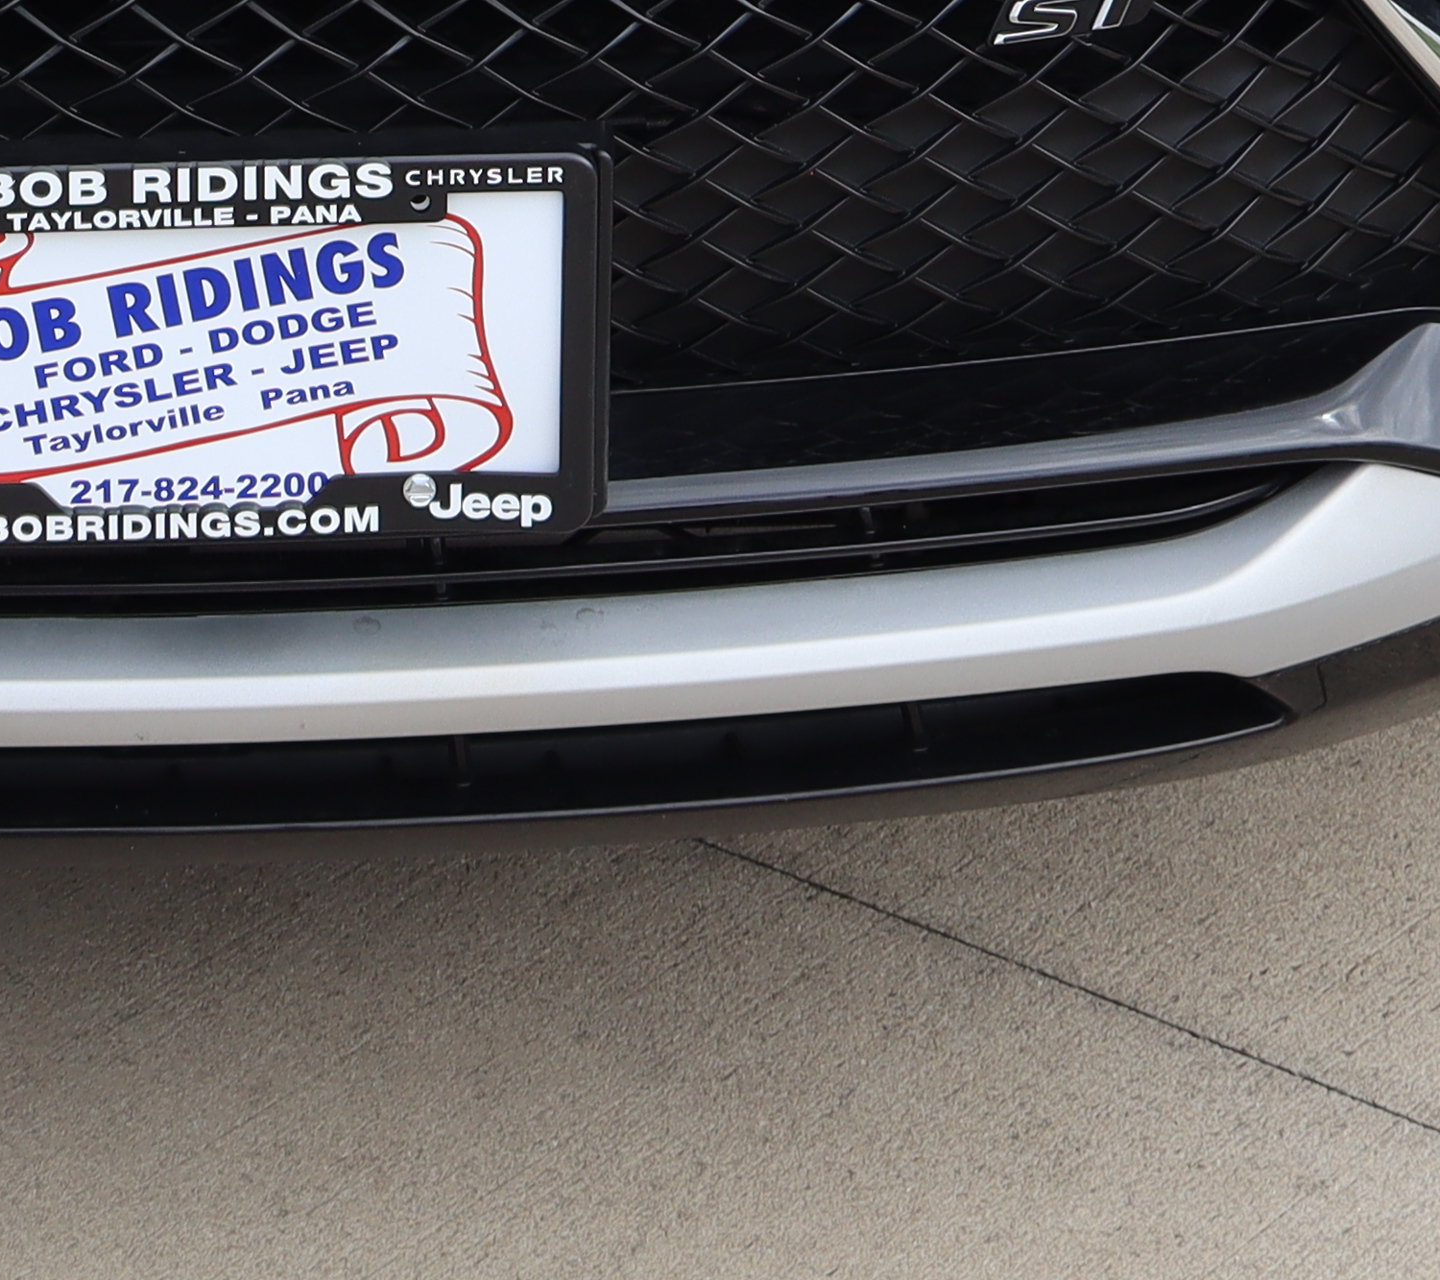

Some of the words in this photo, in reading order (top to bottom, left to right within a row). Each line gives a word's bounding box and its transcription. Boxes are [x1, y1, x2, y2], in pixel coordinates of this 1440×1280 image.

[132, 162, 393, 204] RIDINGS
[405, 166, 563, 187] CHRYSLER
[7, 207, 234, 231] TAYLORVILLE
[270, 204, 362, 225] PANA
[106, 232, 406, 339] RIDINGS
[34, 343, 164, 389] FORD
[209, 301, 378, 354] DODGE
[280, 333, 400, 375] JEEP
[23, 403, 225, 455] Taylorville
[260, 377, 356, 411] Pana
[69, 471, 329, 505] 217-824-2200
[428, 482, 553, 527] Jeep
